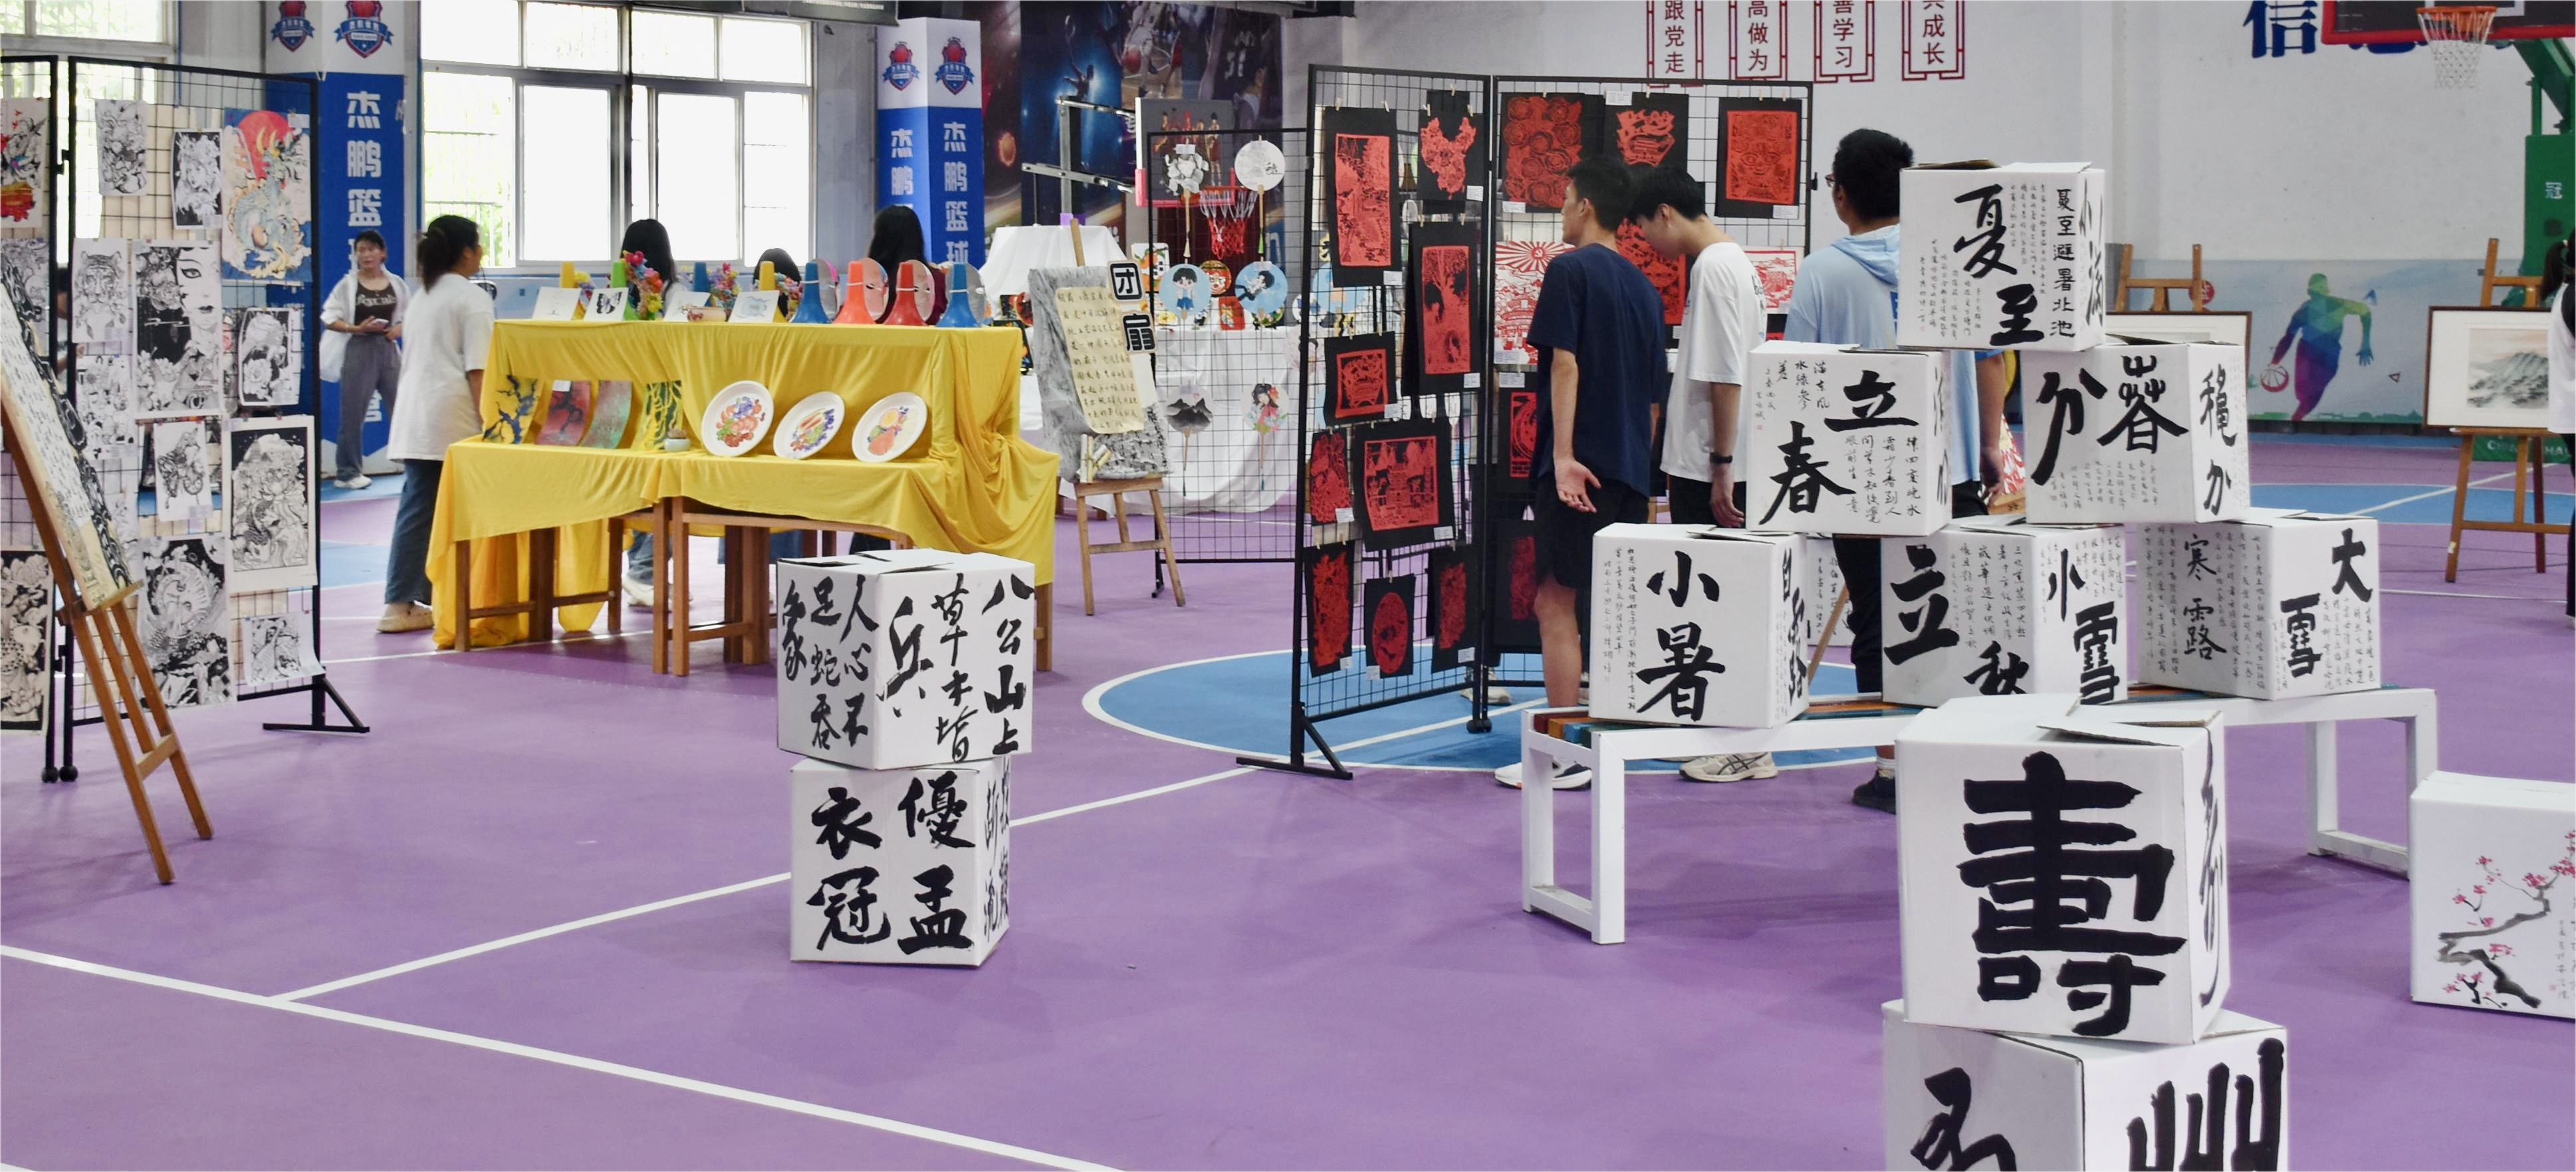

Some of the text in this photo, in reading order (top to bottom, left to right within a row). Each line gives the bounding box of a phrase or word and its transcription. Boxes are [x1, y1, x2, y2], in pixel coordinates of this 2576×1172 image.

[1110, 262, 1156, 352] 团扇
[1953, 183, 2045, 346] 夏至
[1758, 370, 1920, 525] 立春
[810, 576, 842, 751] 足蛇吞
[840, 574, 879, 747] 人心不
[982, 573, 1035, 755] 八公山上
[1635, 550, 1726, 722] 小暑
[2048, 548, 2121, 705] 小雪
[2182, 533, 2227, 661] 寒露
[2280, 527, 2373, 679] 大雪
[806, 786, 891, 951] 衣冠
